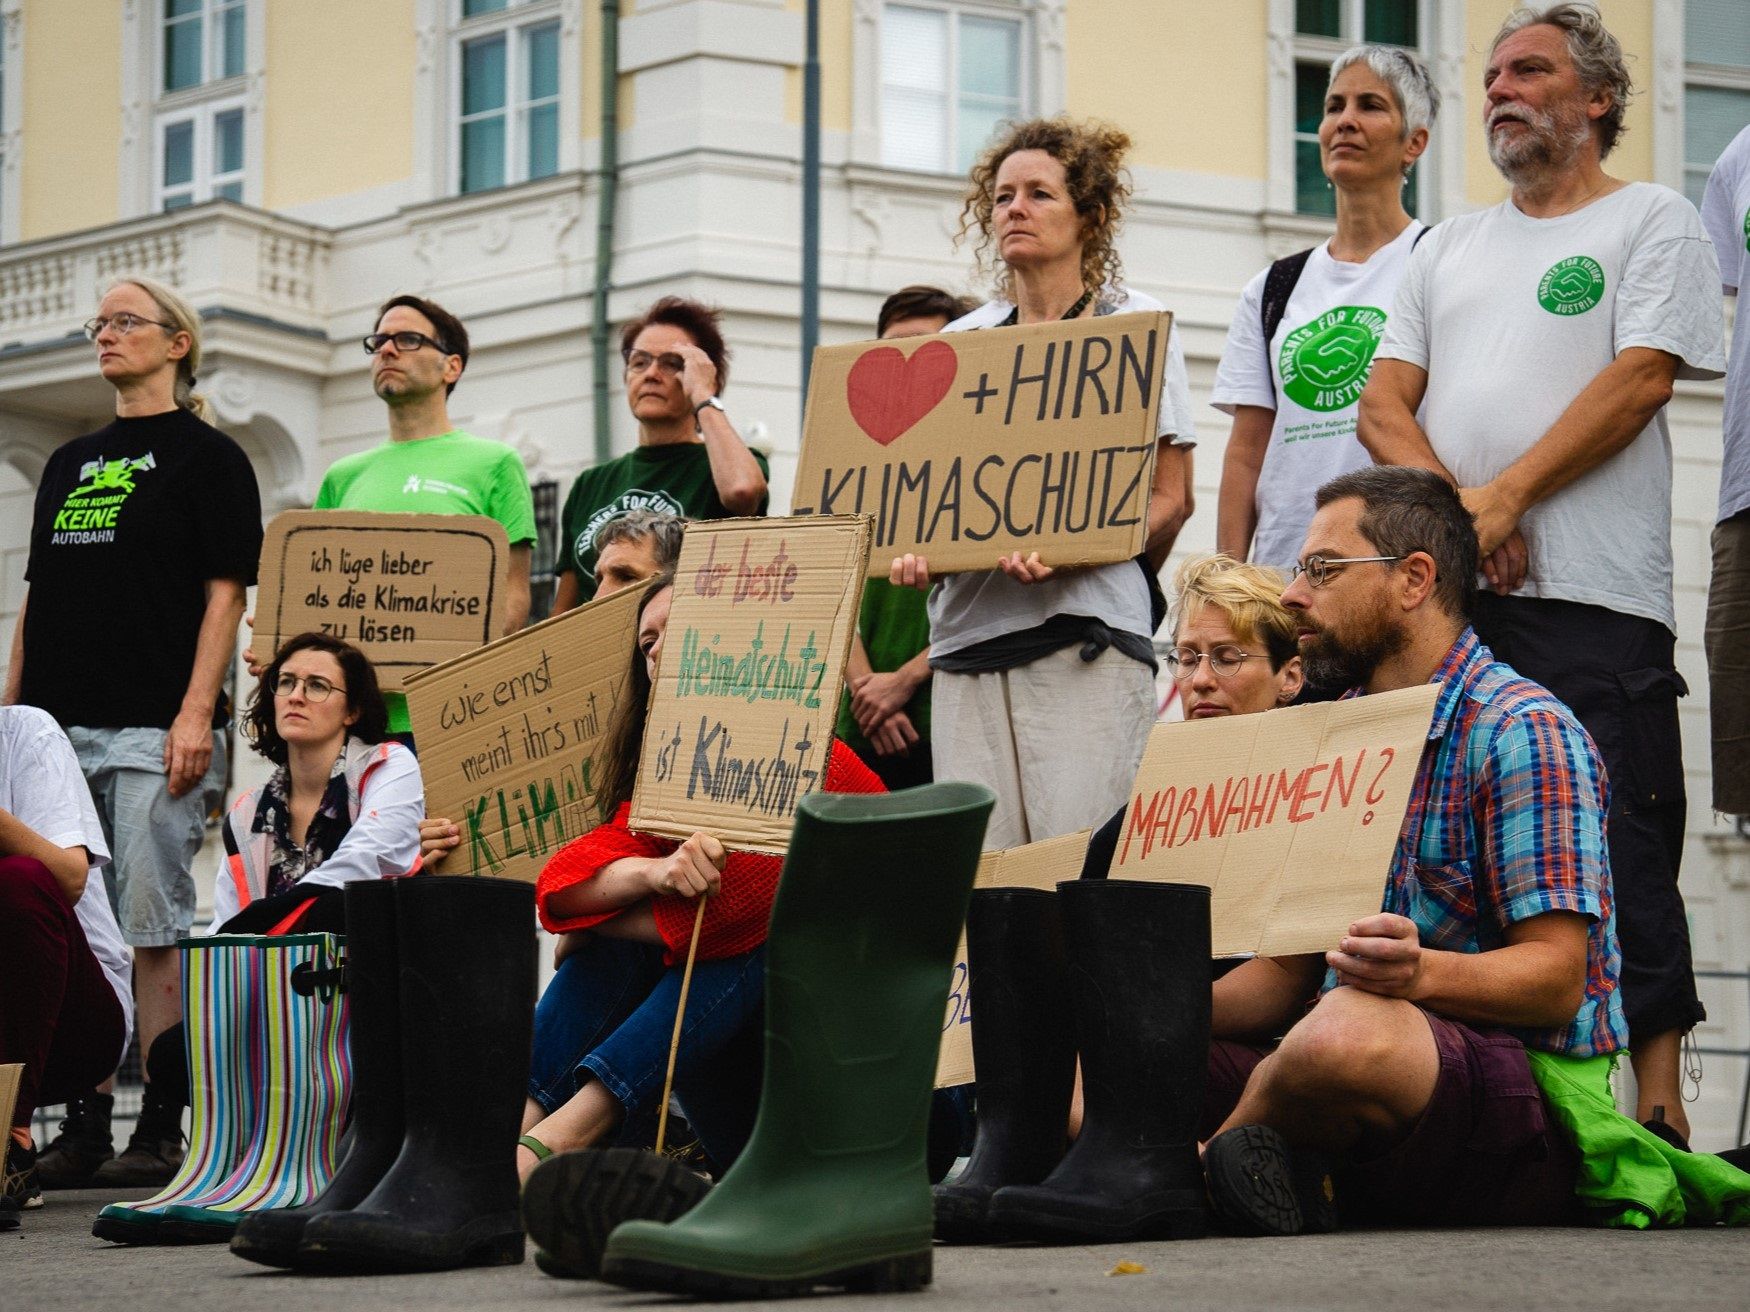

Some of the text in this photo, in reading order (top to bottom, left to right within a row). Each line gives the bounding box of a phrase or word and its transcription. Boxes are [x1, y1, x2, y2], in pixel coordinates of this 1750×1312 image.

[1561, 257, 1578, 268] FOR
[1581, 258, 1602, 284] FUTURE
[1555, 297, 1595, 313] AUSTRIA
[1281, 310, 1384, 384] PARENTS FOR FUTURE
[64, 495, 127, 508] HIER KOMMT
[622, 495, 649, 510] FOR
[54, 506, 121, 529] KEINE
[52, 530, 114, 545] AUTOBAHN
[311, 547, 433, 584] ich lüge lieber
[694, 534, 798, 608] der beste
[305, 584, 480, 615] als die Klimakrise
[320, 615, 415, 642] zu lösen
[677, 619, 828, 709] Heimatschutz
[440, 650, 552, 730] wie ernst
[461, 725, 513, 783] meint
[574, 691, 599, 741] mit
[655, 715, 818, 818] ist Klimaschutz
